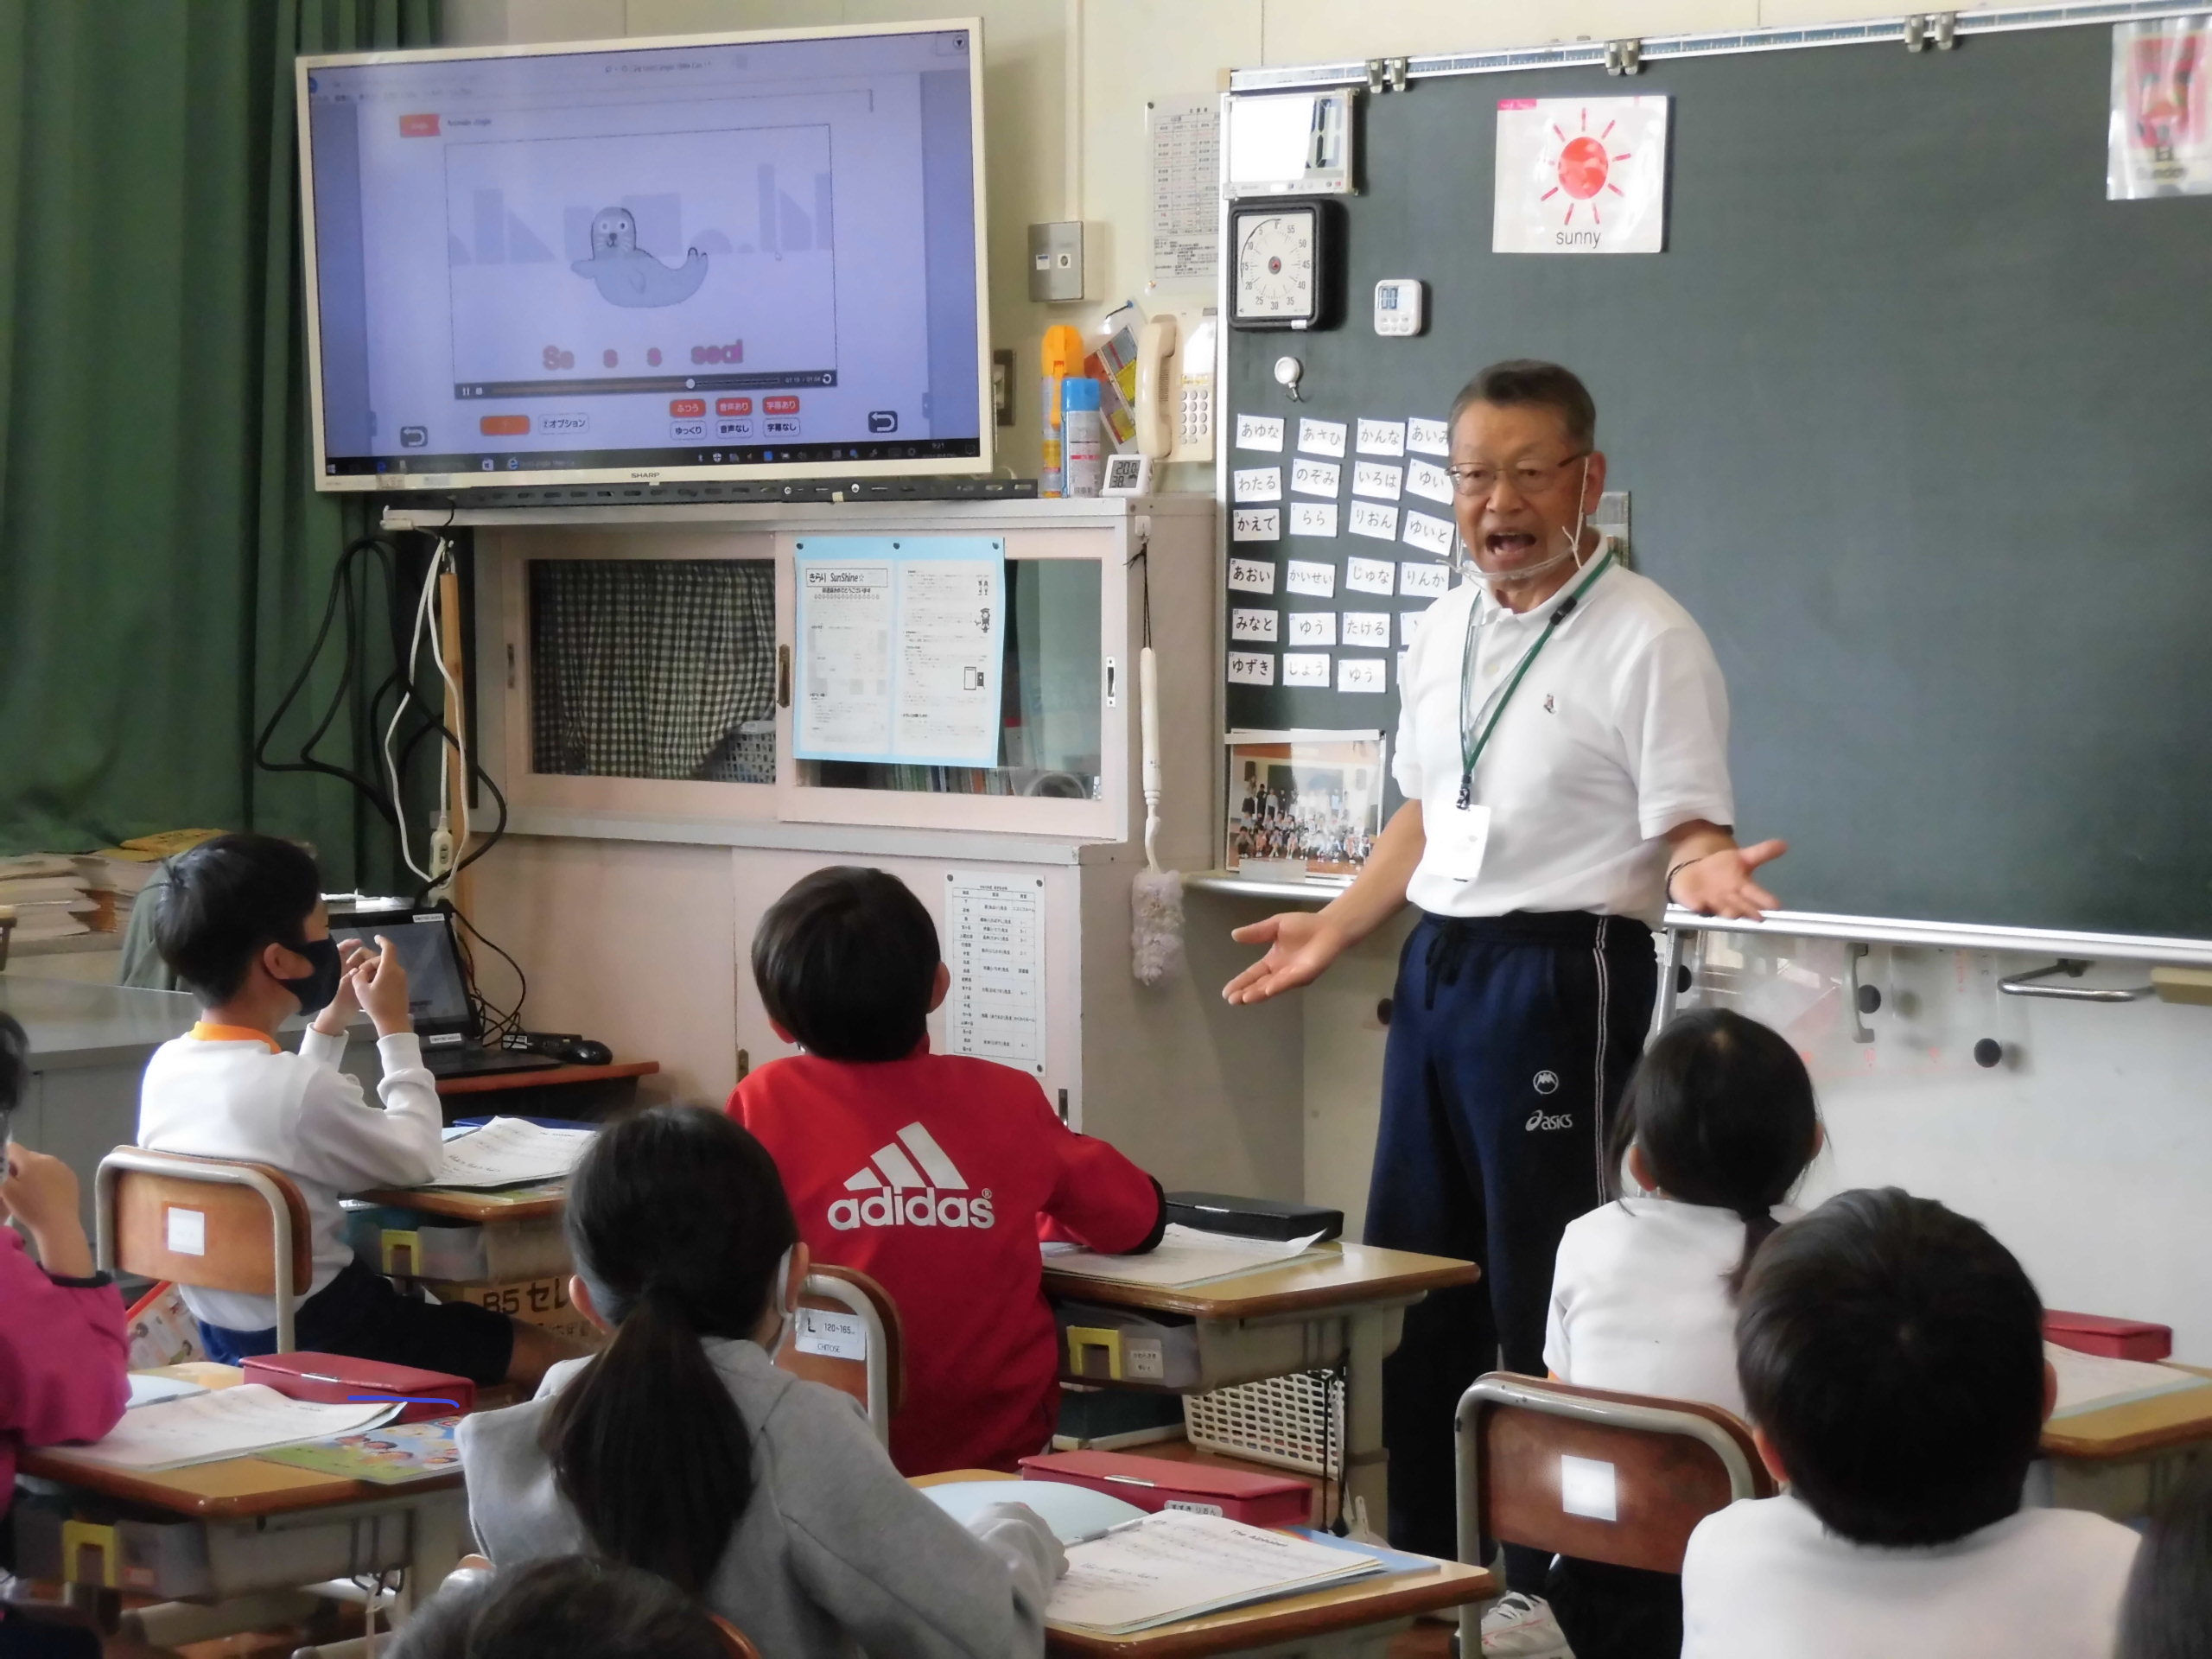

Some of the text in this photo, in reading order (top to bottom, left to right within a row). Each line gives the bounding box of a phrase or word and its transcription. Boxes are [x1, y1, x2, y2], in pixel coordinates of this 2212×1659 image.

[1287, 225, 1295, 234] 55
[1299, 238, 1307, 248] 50
[1556, 232, 1601, 249] sunny
[1302, 260, 1311, 269] 45
[1245, 281, 1253, 290] 20
[1297, 281, 1306, 289] 40
[1255, 296, 1264, 305] 25
[1270, 301, 1279, 310] 30
[1286, 296, 1295, 306] 35
[677, 404, 699, 413] ふつう
[720, 402, 749, 412] 音声あり
[766, 400, 796, 410] 字幕あり
[549, 419, 586, 429] オプション
[675, 426, 702, 435] ゆっくり
[721, 424, 750, 434] 音声なし
[767, 423, 797, 432] 字幕なし
[1241, 423, 1279, 439] あゆな
[1302, 426, 1341, 445] あさひ
[1361, 429, 1400, 445] かんな
[1238, 474, 1276, 493] わたる
[1296, 467, 1335, 486] のぞみ
[1358, 469, 1397, 488] いろは
[1237, 516, 1276, 531] かえで
[1302, 509, 1325, 526] らら
[1356, 509, 1392, 529] りおん
[1409, 520, 1448, 543] ゆいと
[809, 572, 859, 583] きらり SunShine
[1233, 565, 1270, 582] あおい
[1288, 569, 1332, 585] かいせい
[1353, 565, 1390, 584] じゅな
[1407, 570, 1445, 588] りんか
[1236, 615, 1273, 632] みなと
[1300, 619, 1324, 636] ゆう
[1346, 619, 1385, 636] たける
[1232, 658, 1268, 676] ゆずき
[1349, 666, 1373, 683] ゆう
[828, 1186, 995, 1230] adidas
[807, 1317, 817, 1333] L
[817, 1343, 841, 1353] CHITOSE
